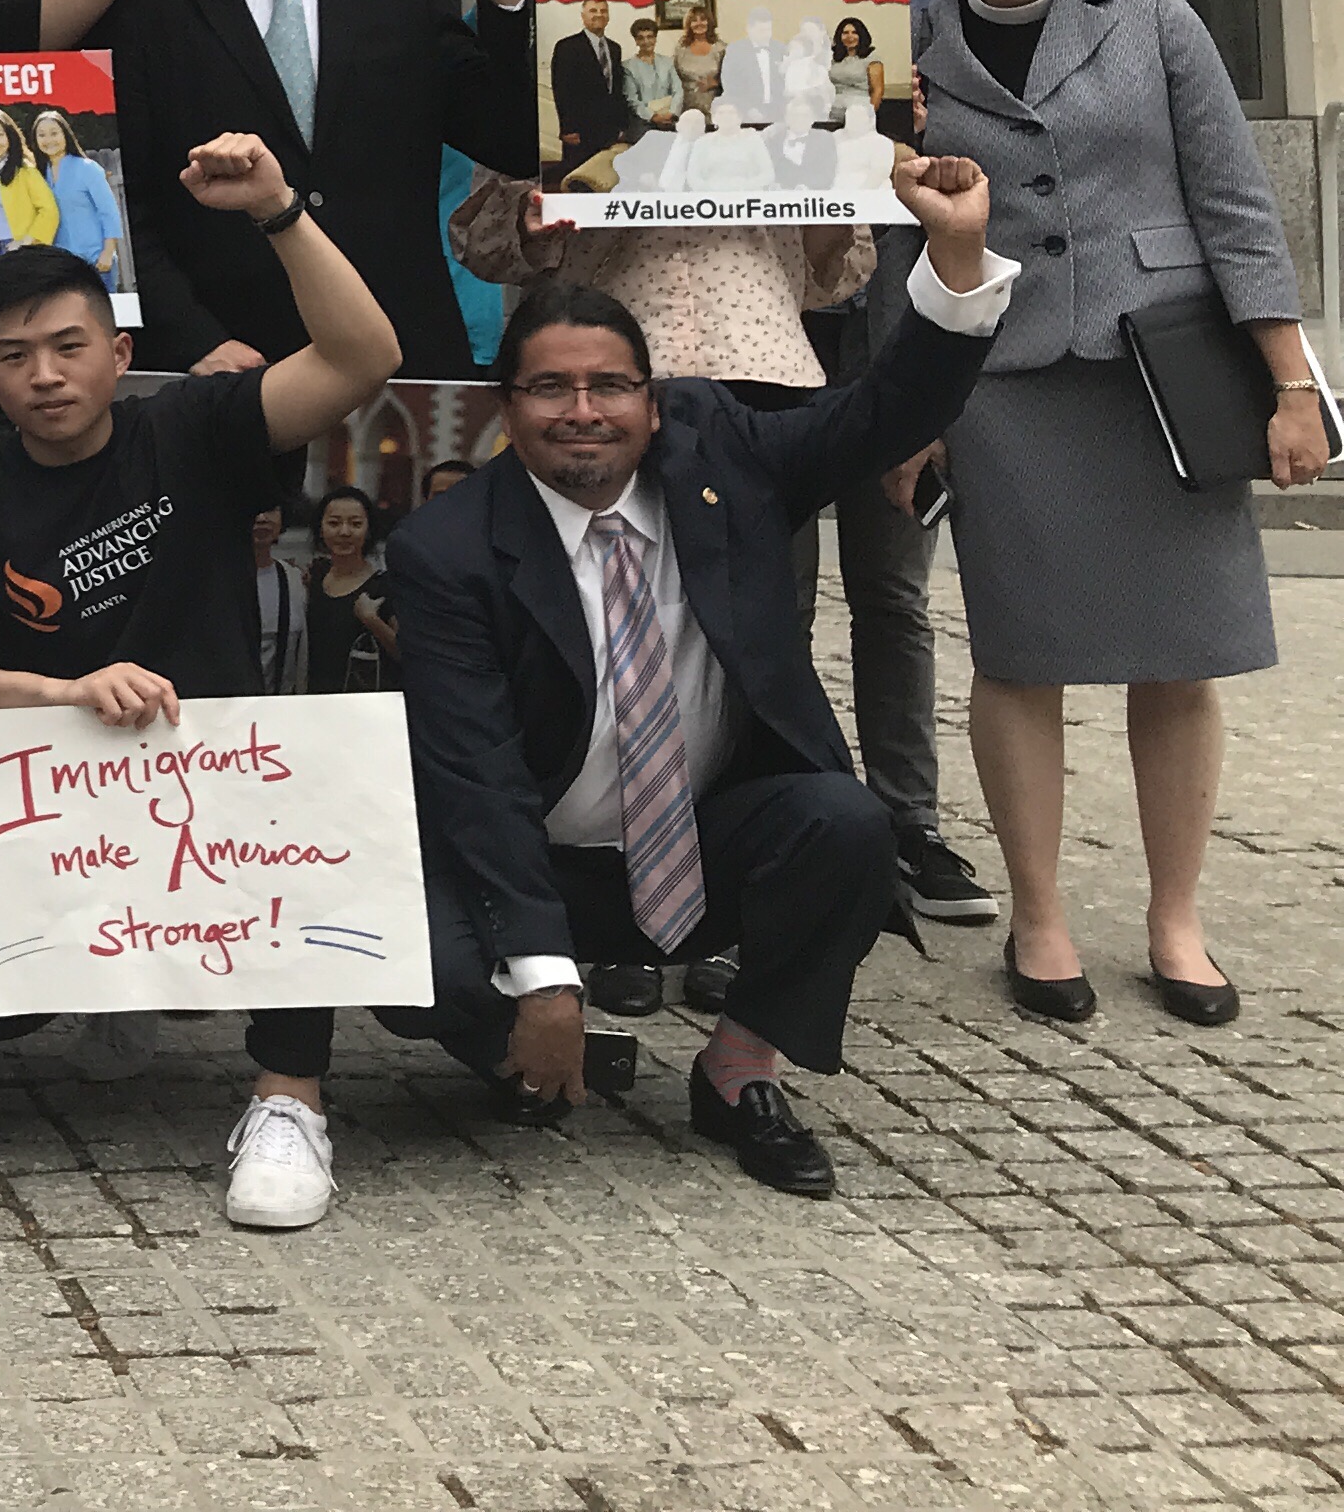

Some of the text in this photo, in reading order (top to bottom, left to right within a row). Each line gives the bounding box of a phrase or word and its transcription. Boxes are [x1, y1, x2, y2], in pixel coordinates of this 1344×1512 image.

[604, 197, 857, 222] #ValueOurFamilies
[58, 502, 152, 558] ASIAN AMERICANS
[68, 544, 154, 602] JUSTICE
[80, 593, 128, 620] ATLANTA
[50, 819, 352, 893] make America
